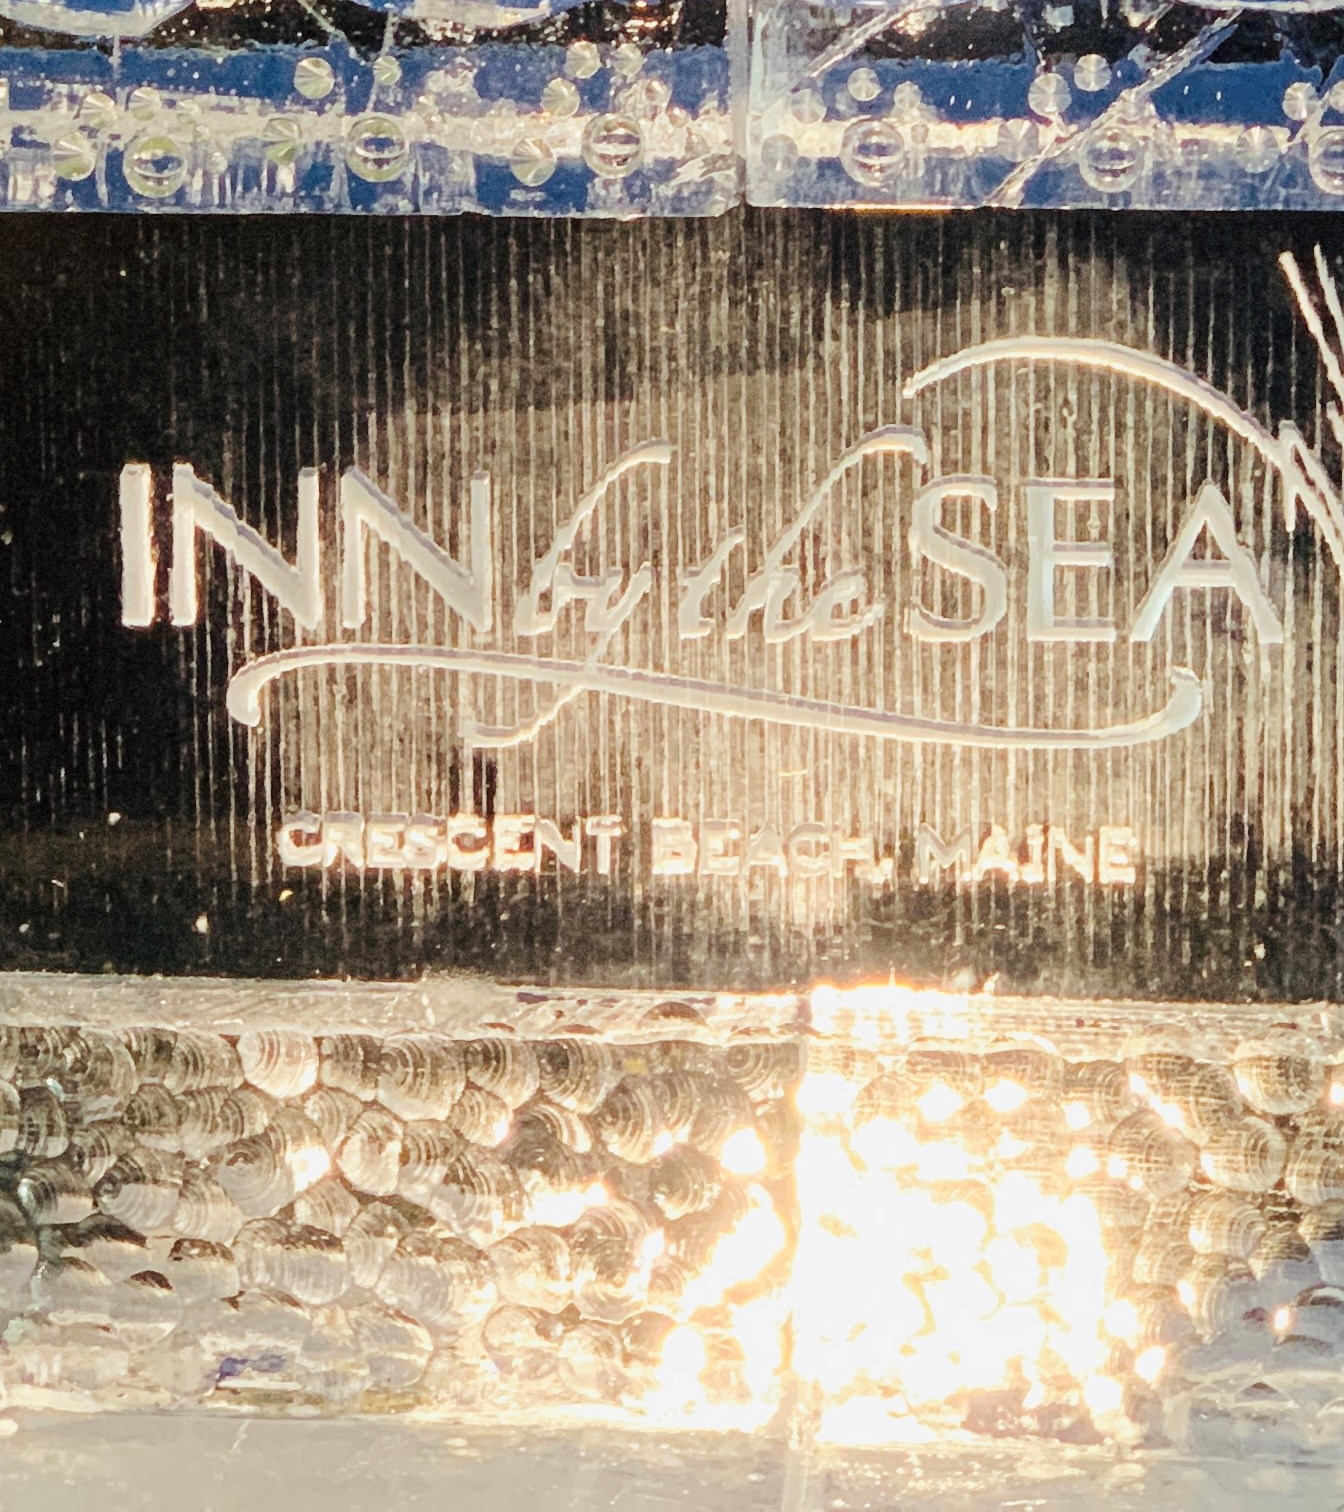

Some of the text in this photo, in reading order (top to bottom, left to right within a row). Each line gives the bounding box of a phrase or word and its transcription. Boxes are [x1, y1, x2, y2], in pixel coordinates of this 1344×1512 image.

[118, 423, 1285, 750] INN by the SEA
[276, 809, 626, 876] CRESCENT
[914, 820, 1138, 885] MAINE
